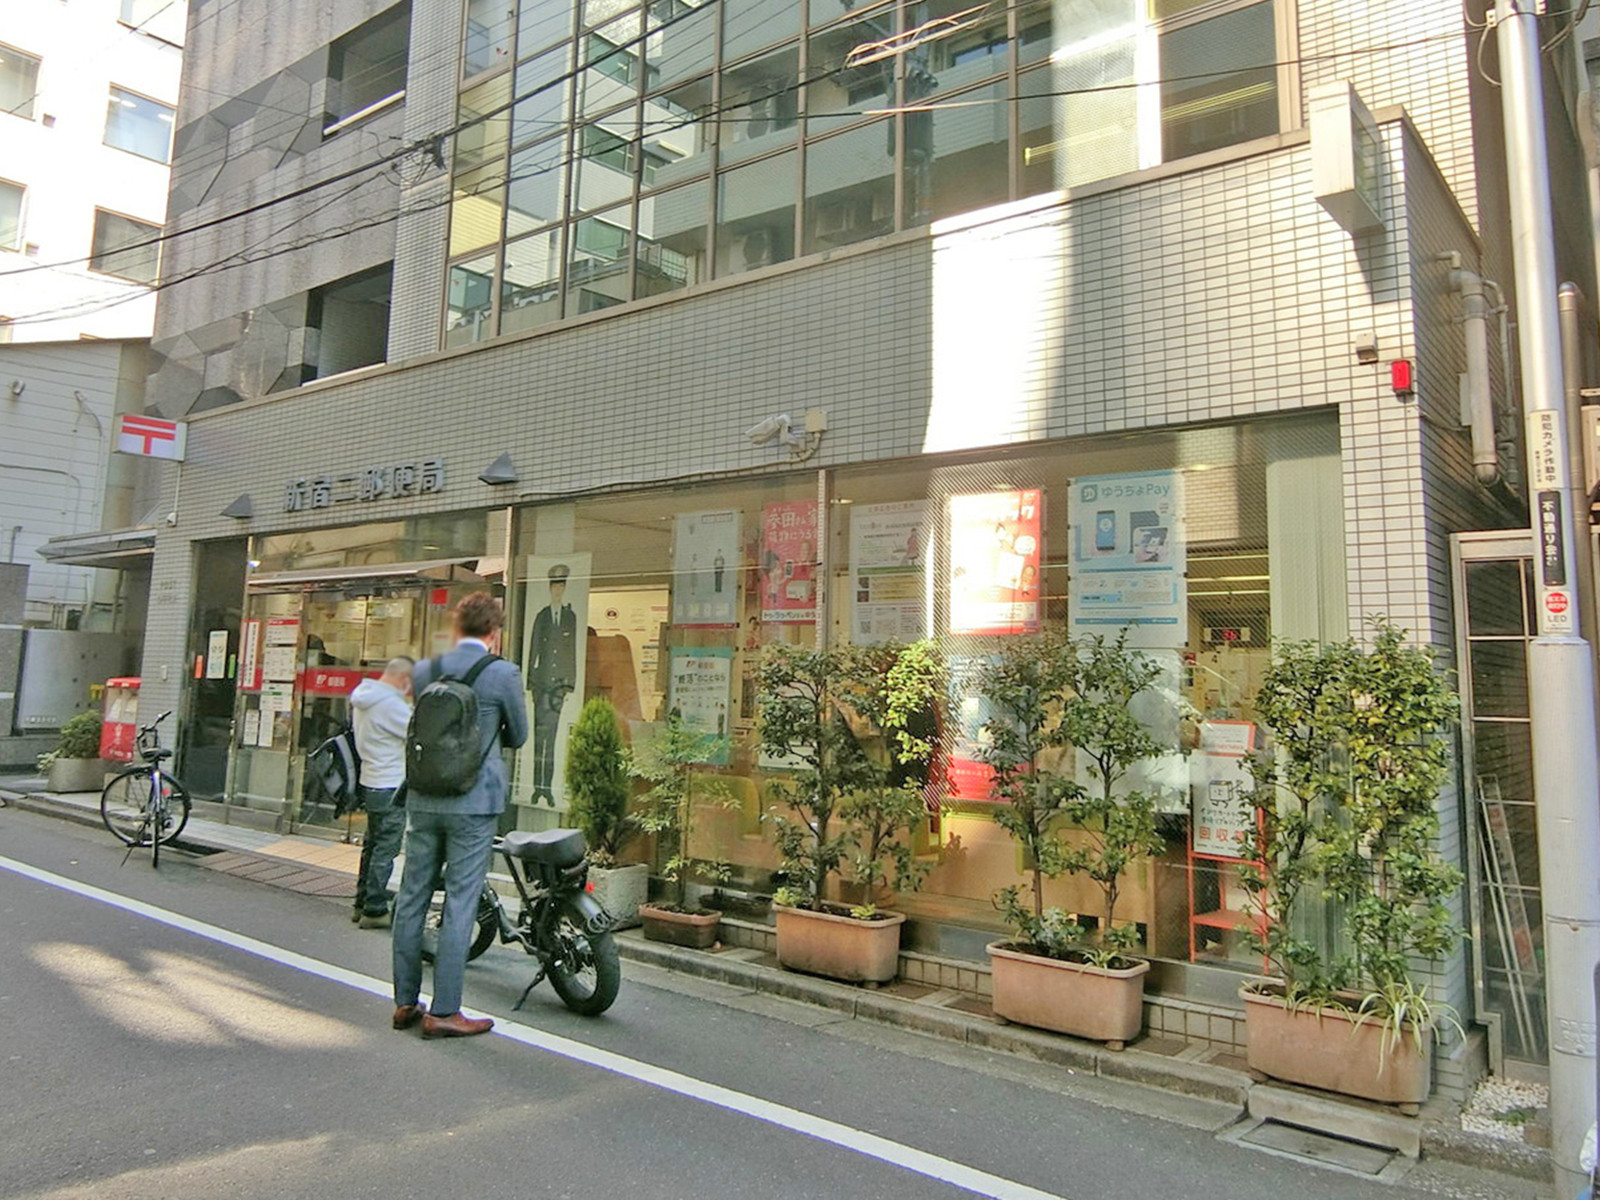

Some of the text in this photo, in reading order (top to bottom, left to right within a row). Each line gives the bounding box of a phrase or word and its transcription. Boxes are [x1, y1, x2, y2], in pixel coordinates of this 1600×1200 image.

[1540, 413, 1557, 483] 防犯カメラ作動中
[282, 457, 444, 513] 新宿二郵便局
[1101, 483, 1170, 498] ゆうちょPay
[1547, 614, 1568, 623] LED
